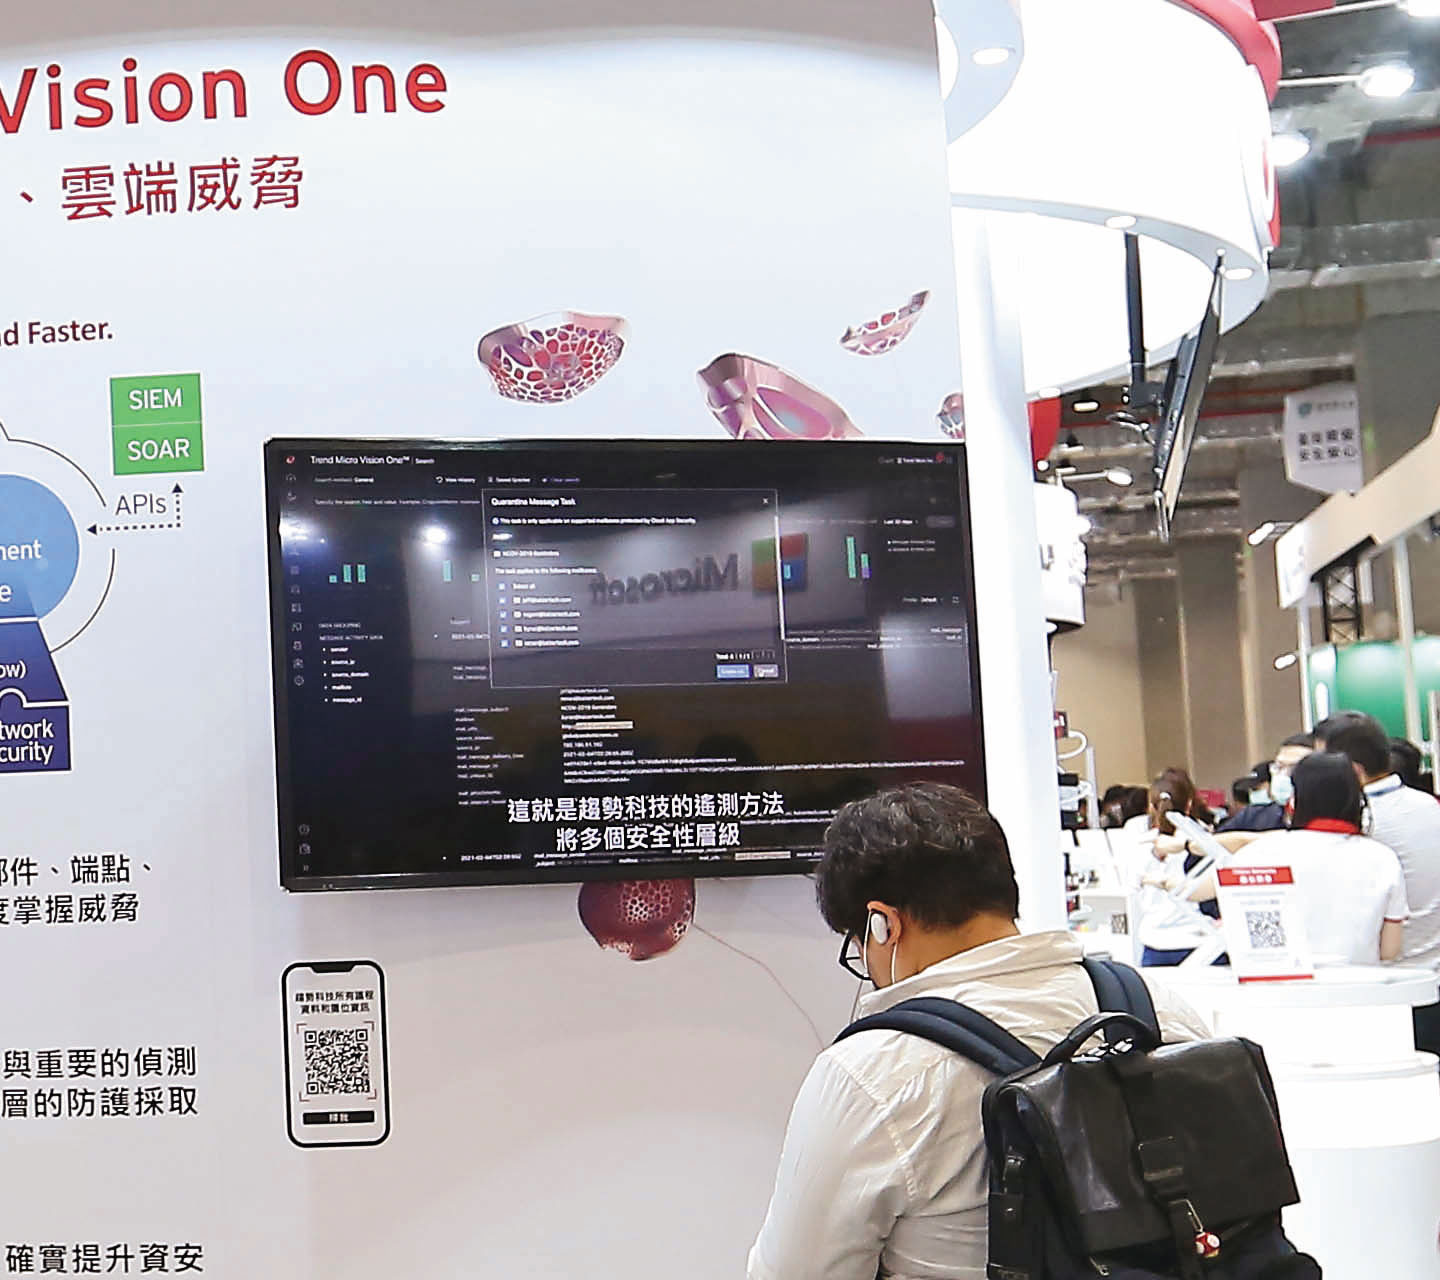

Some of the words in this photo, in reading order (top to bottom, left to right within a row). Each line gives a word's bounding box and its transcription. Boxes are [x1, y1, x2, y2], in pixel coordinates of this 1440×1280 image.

[282, 49, 448, 120] One
[27, 320, 113, 346] Faster.
[129, 389, 182, 410] SIEM
[127, 439, 190, 460] SOAR
[116, 495, 166, 516] APIs
[508, 791, 784, 822] 這就是趨勢科技的遙測方法
[556, 823, 740, 852] 將多個安全性層級
